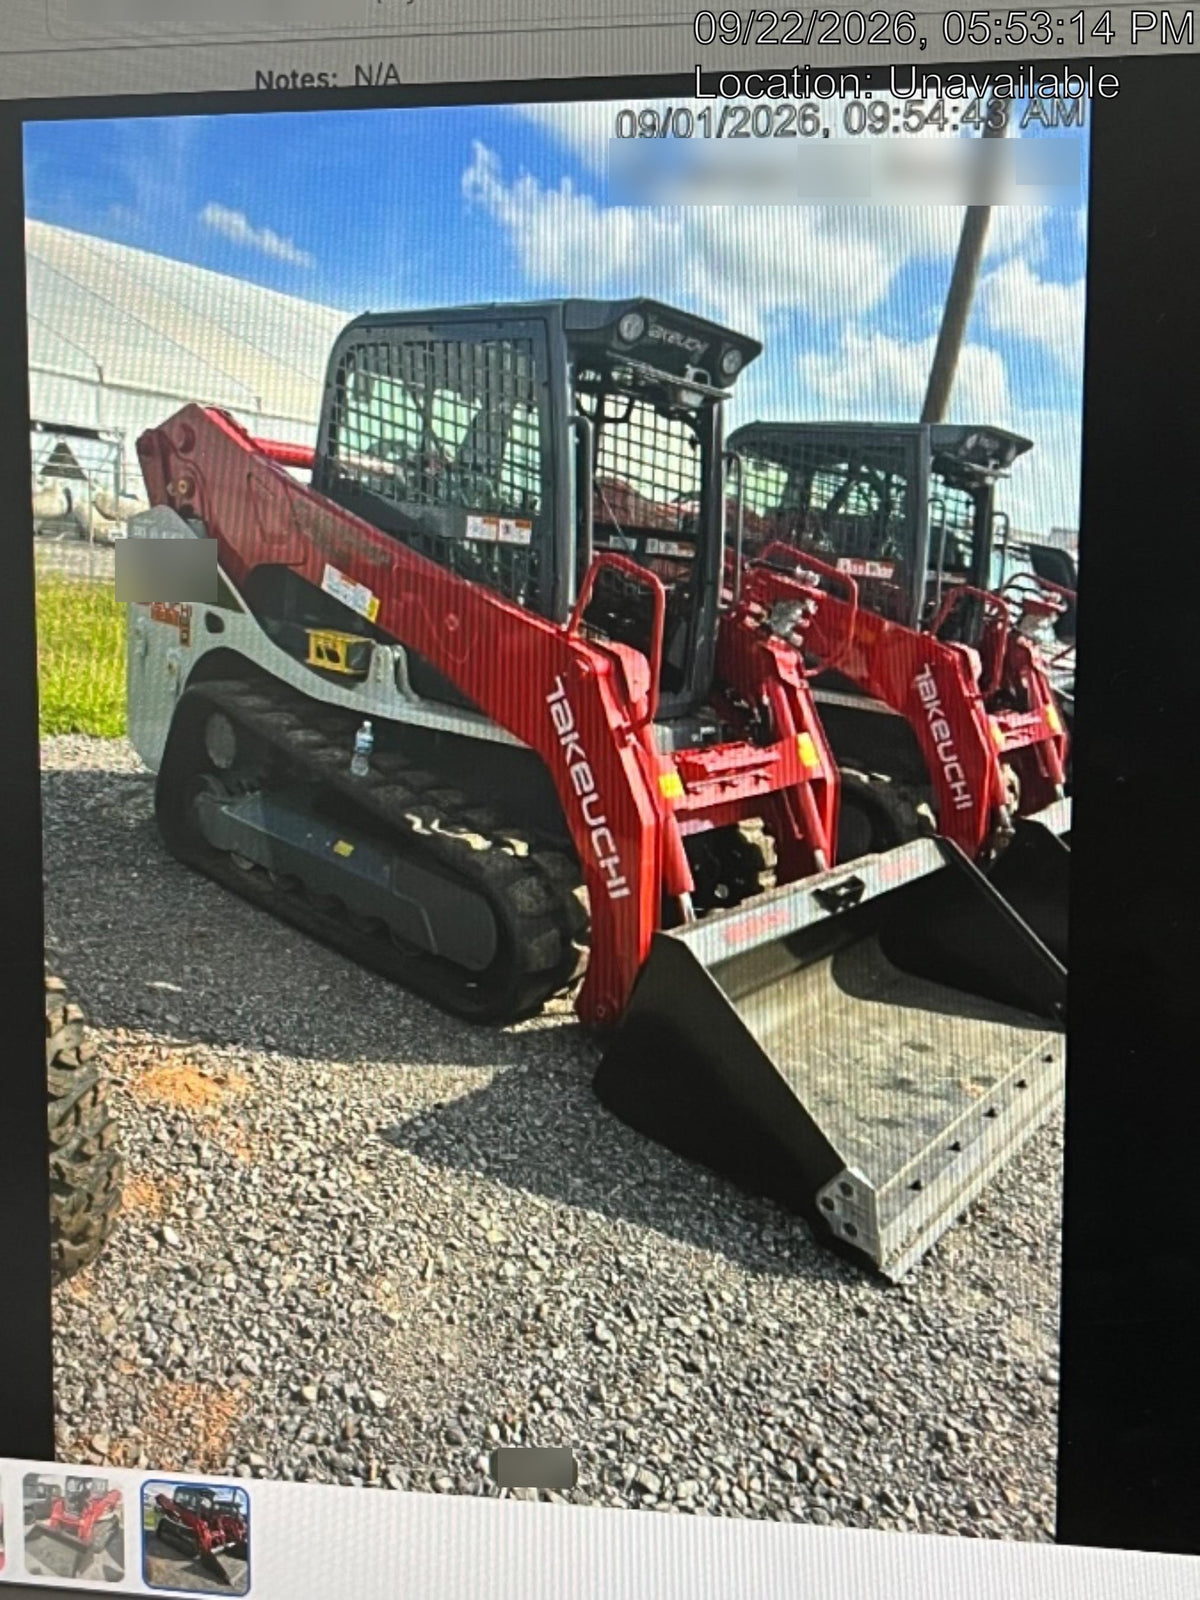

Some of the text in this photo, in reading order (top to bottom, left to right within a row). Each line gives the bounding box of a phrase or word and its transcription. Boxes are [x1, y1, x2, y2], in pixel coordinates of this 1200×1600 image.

[255, 61, 401, 90] Notes: N/A
[615, 92, 1085, 138] 09/01/2026, 09:54:43 AM
[913, 663, 974, 810] TAKEUCHI
[546, 675, 631, 898] TAKEUCHI
